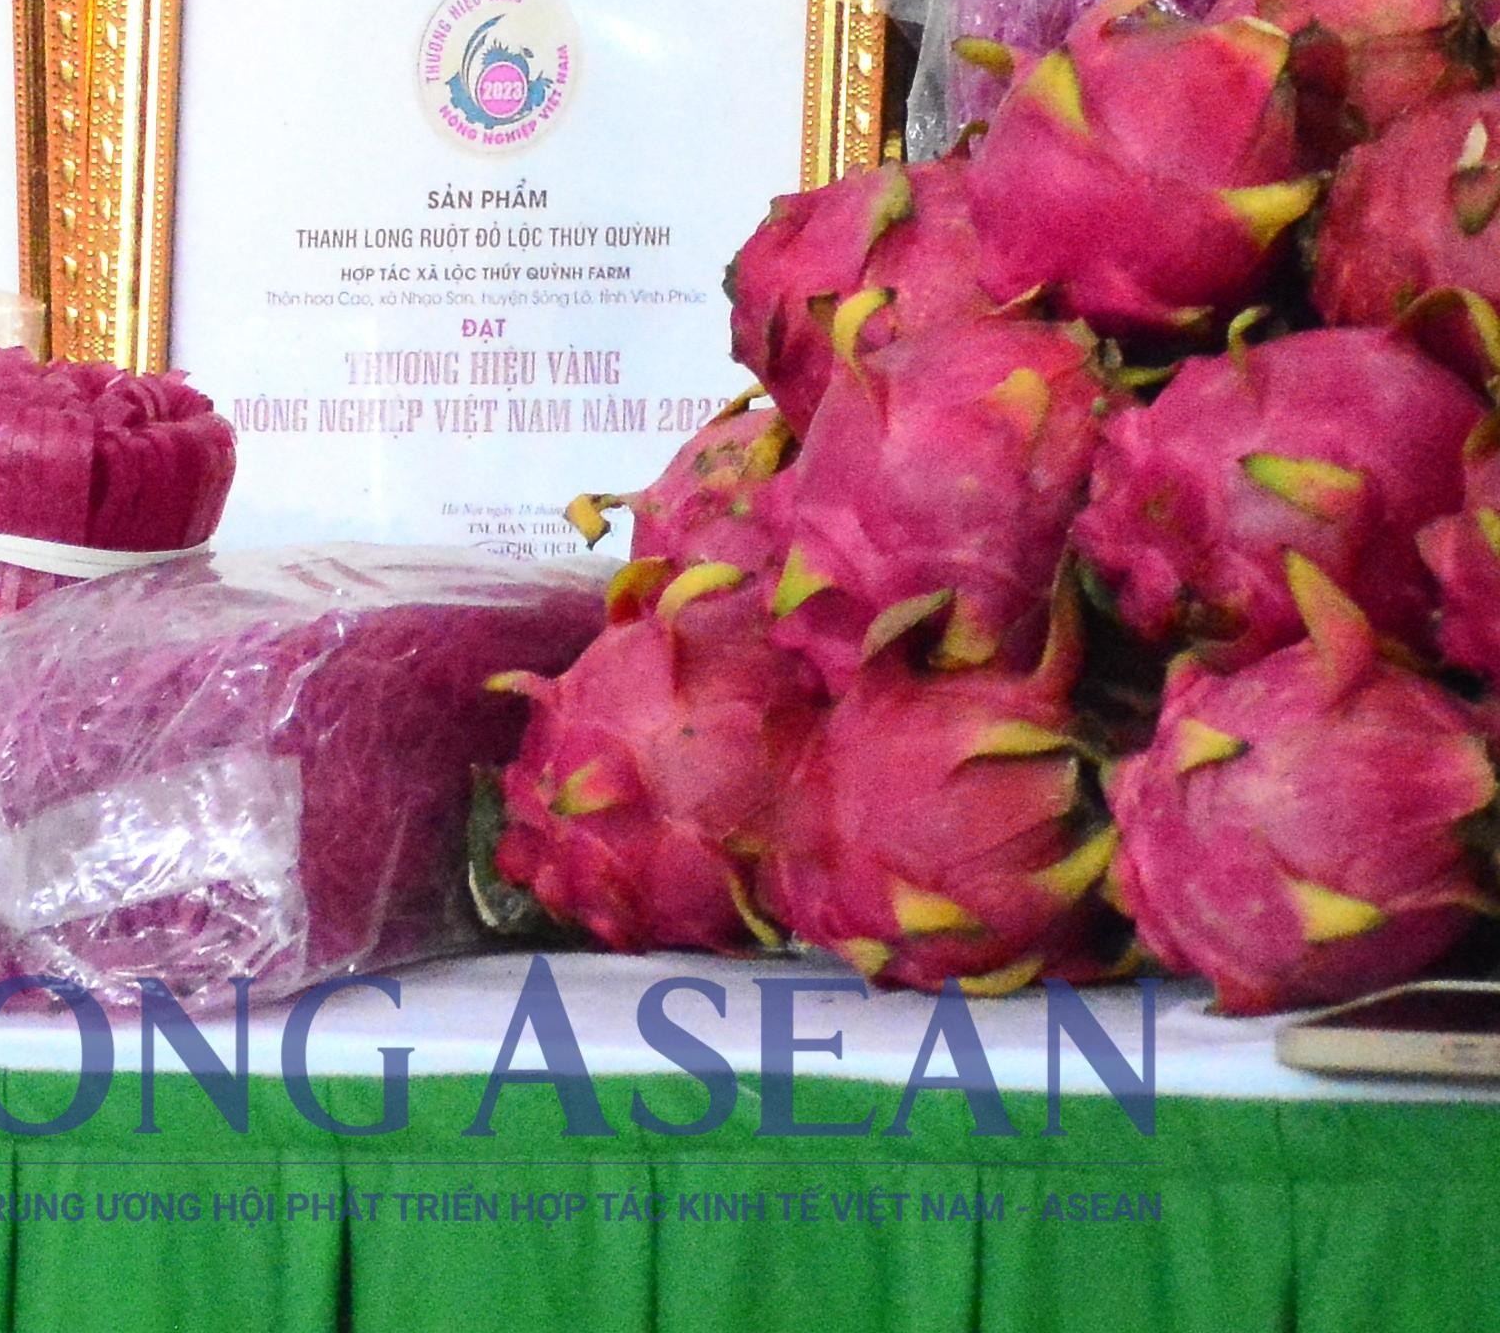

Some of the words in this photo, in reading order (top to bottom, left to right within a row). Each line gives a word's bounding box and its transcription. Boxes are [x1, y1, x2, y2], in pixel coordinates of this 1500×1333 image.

[482, 81, 524, 101] 2023
[427, 183, 473, 210] SẢN
[481, 177, 549, 210] PHẨM
[296, 227, 358, 250] THANH
[365, 227, 413, 249] LONG
[420, 222, 469, 252] RUỘT
[475, 220, 501, 249] ĐỎ
[507, 222, 543, 253] LỘC
[604, 221, 671, 247] QUỲNH
[341, 267, 376, 286] HỢP
[379, 262, 411, 282] TÁC
[416, 262, 439, 282] XÃ
[444, 262, 477, 286] LỘC
[482, 262, 522, 283] THÚY
[526, 261, 584, 283] QUỲNH
[588, 265, 631, 281] FARM
[462, 317, 507, 343] ĐẠT
[232, 392, 309, 434] NÔNG
[318, 394, 425, 439] NGHIỆP
[434, 393, 499, 440] VIỆT
[506, 397, 574, 434] NAM
